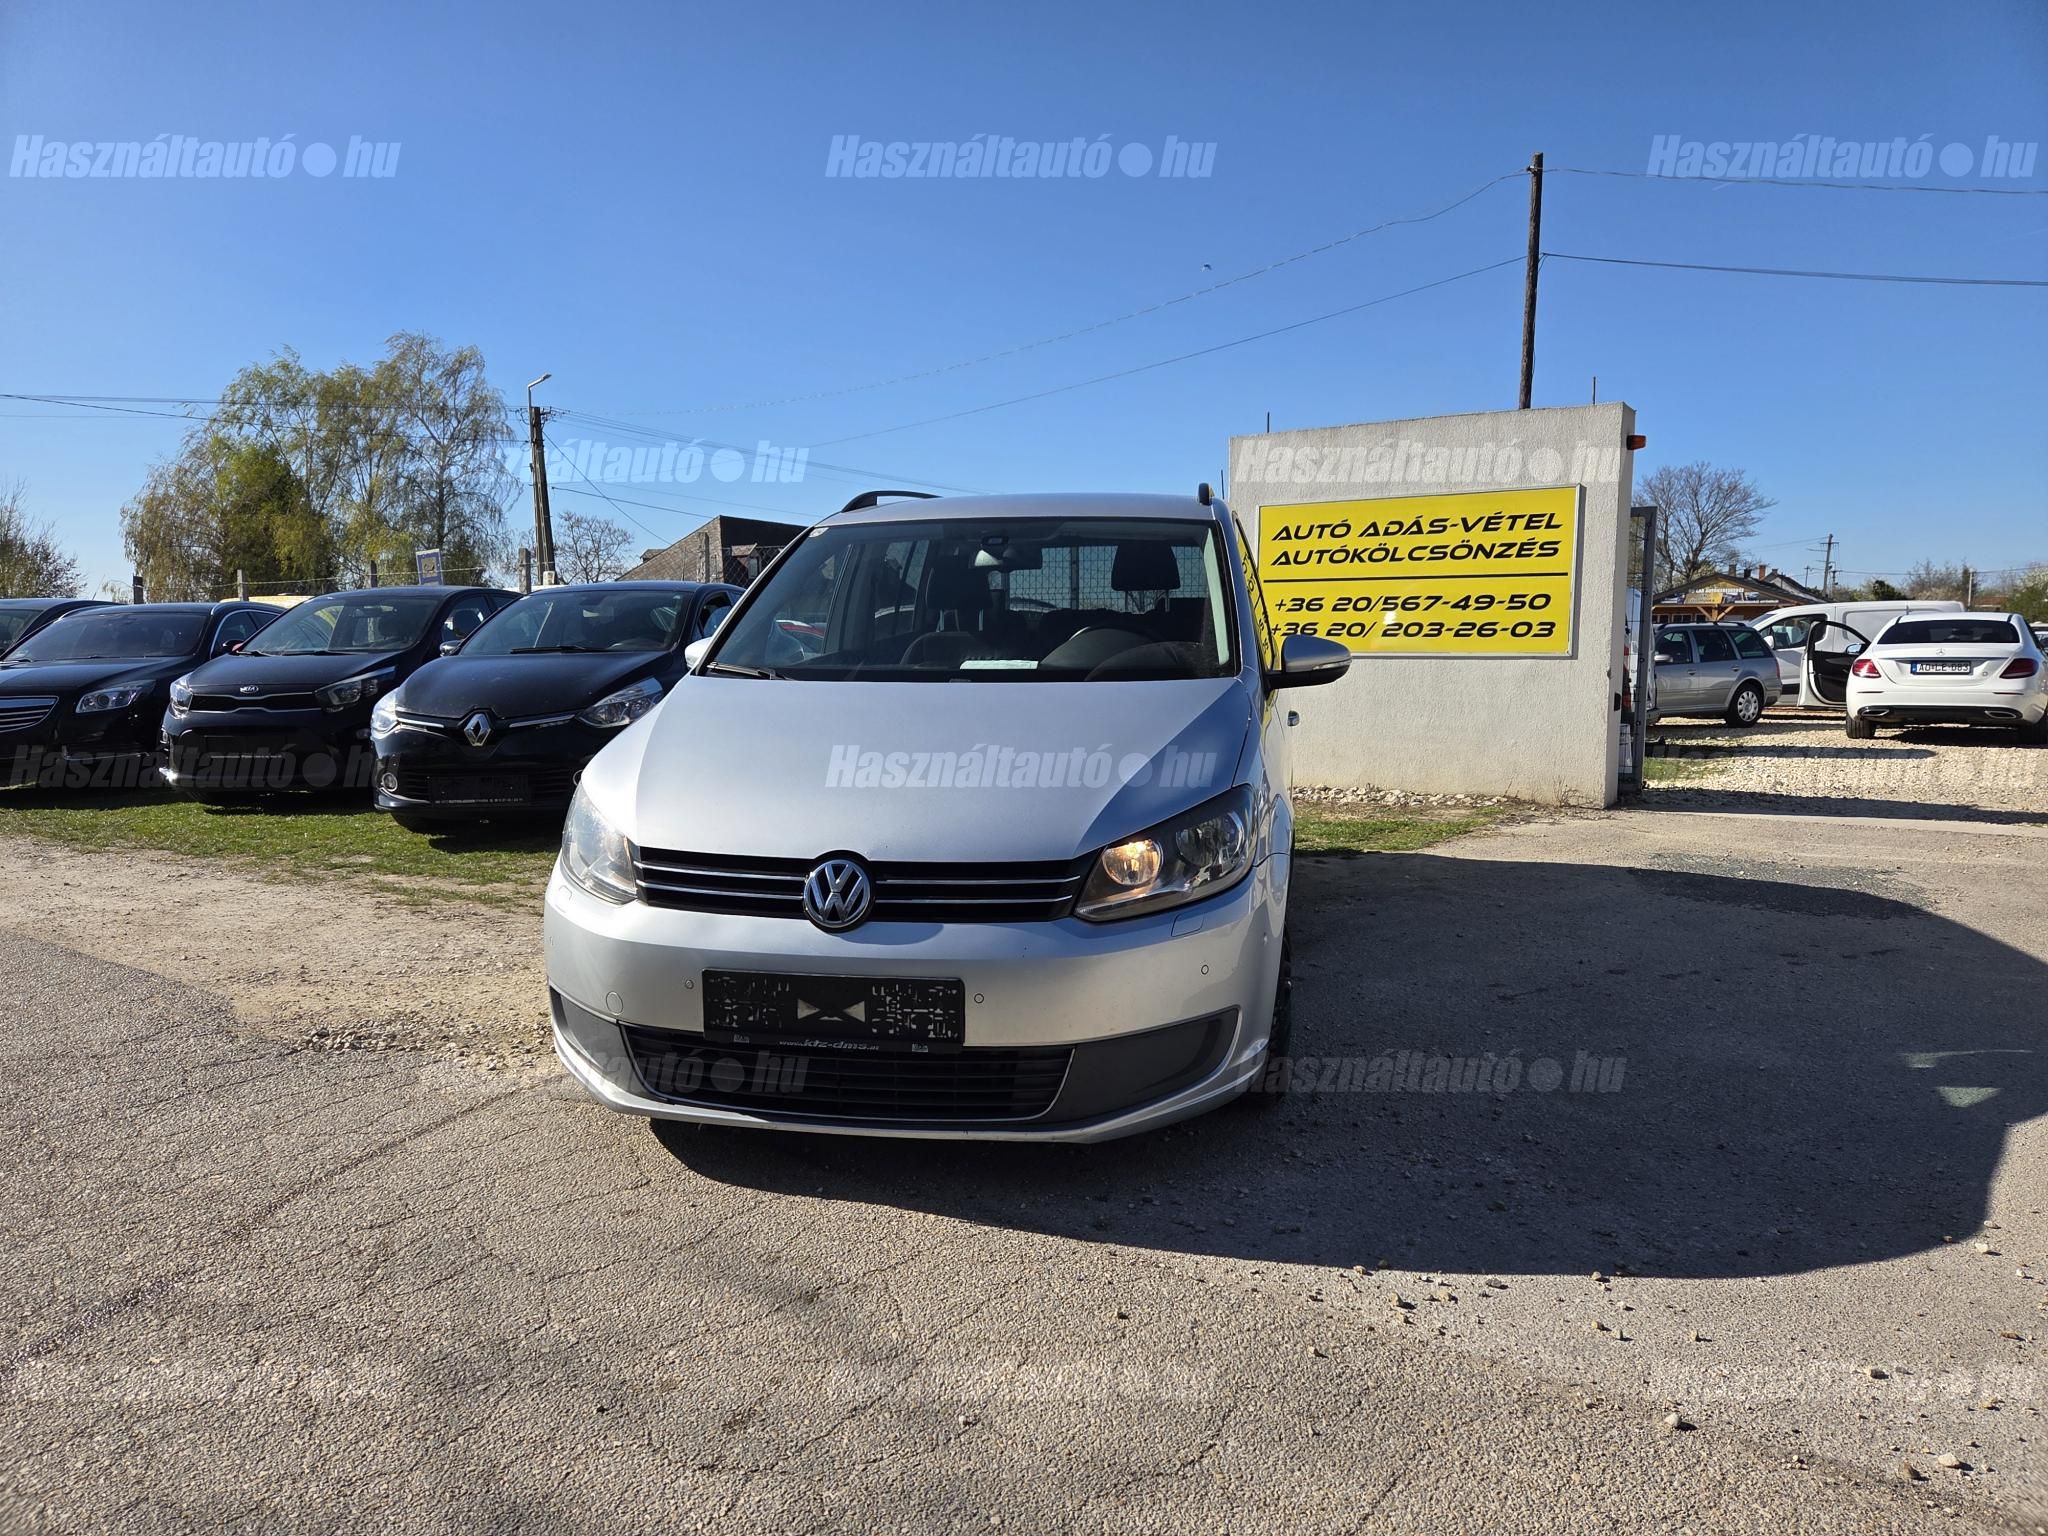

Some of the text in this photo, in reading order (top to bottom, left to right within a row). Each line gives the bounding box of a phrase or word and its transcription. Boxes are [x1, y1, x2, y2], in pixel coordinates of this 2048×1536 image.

[1271, 511, 1564, 541] AUTÓ ADÁS-VÉTEL
[1270, 537, 1561, 566] AUTÓKÖLCSÖNZÉS
[1275, 593, 1552, 612] +36 20/567-49-50
[1271, 621, 1321, 638] +36
[1381, 621, 1556, 638] 203-26-03
